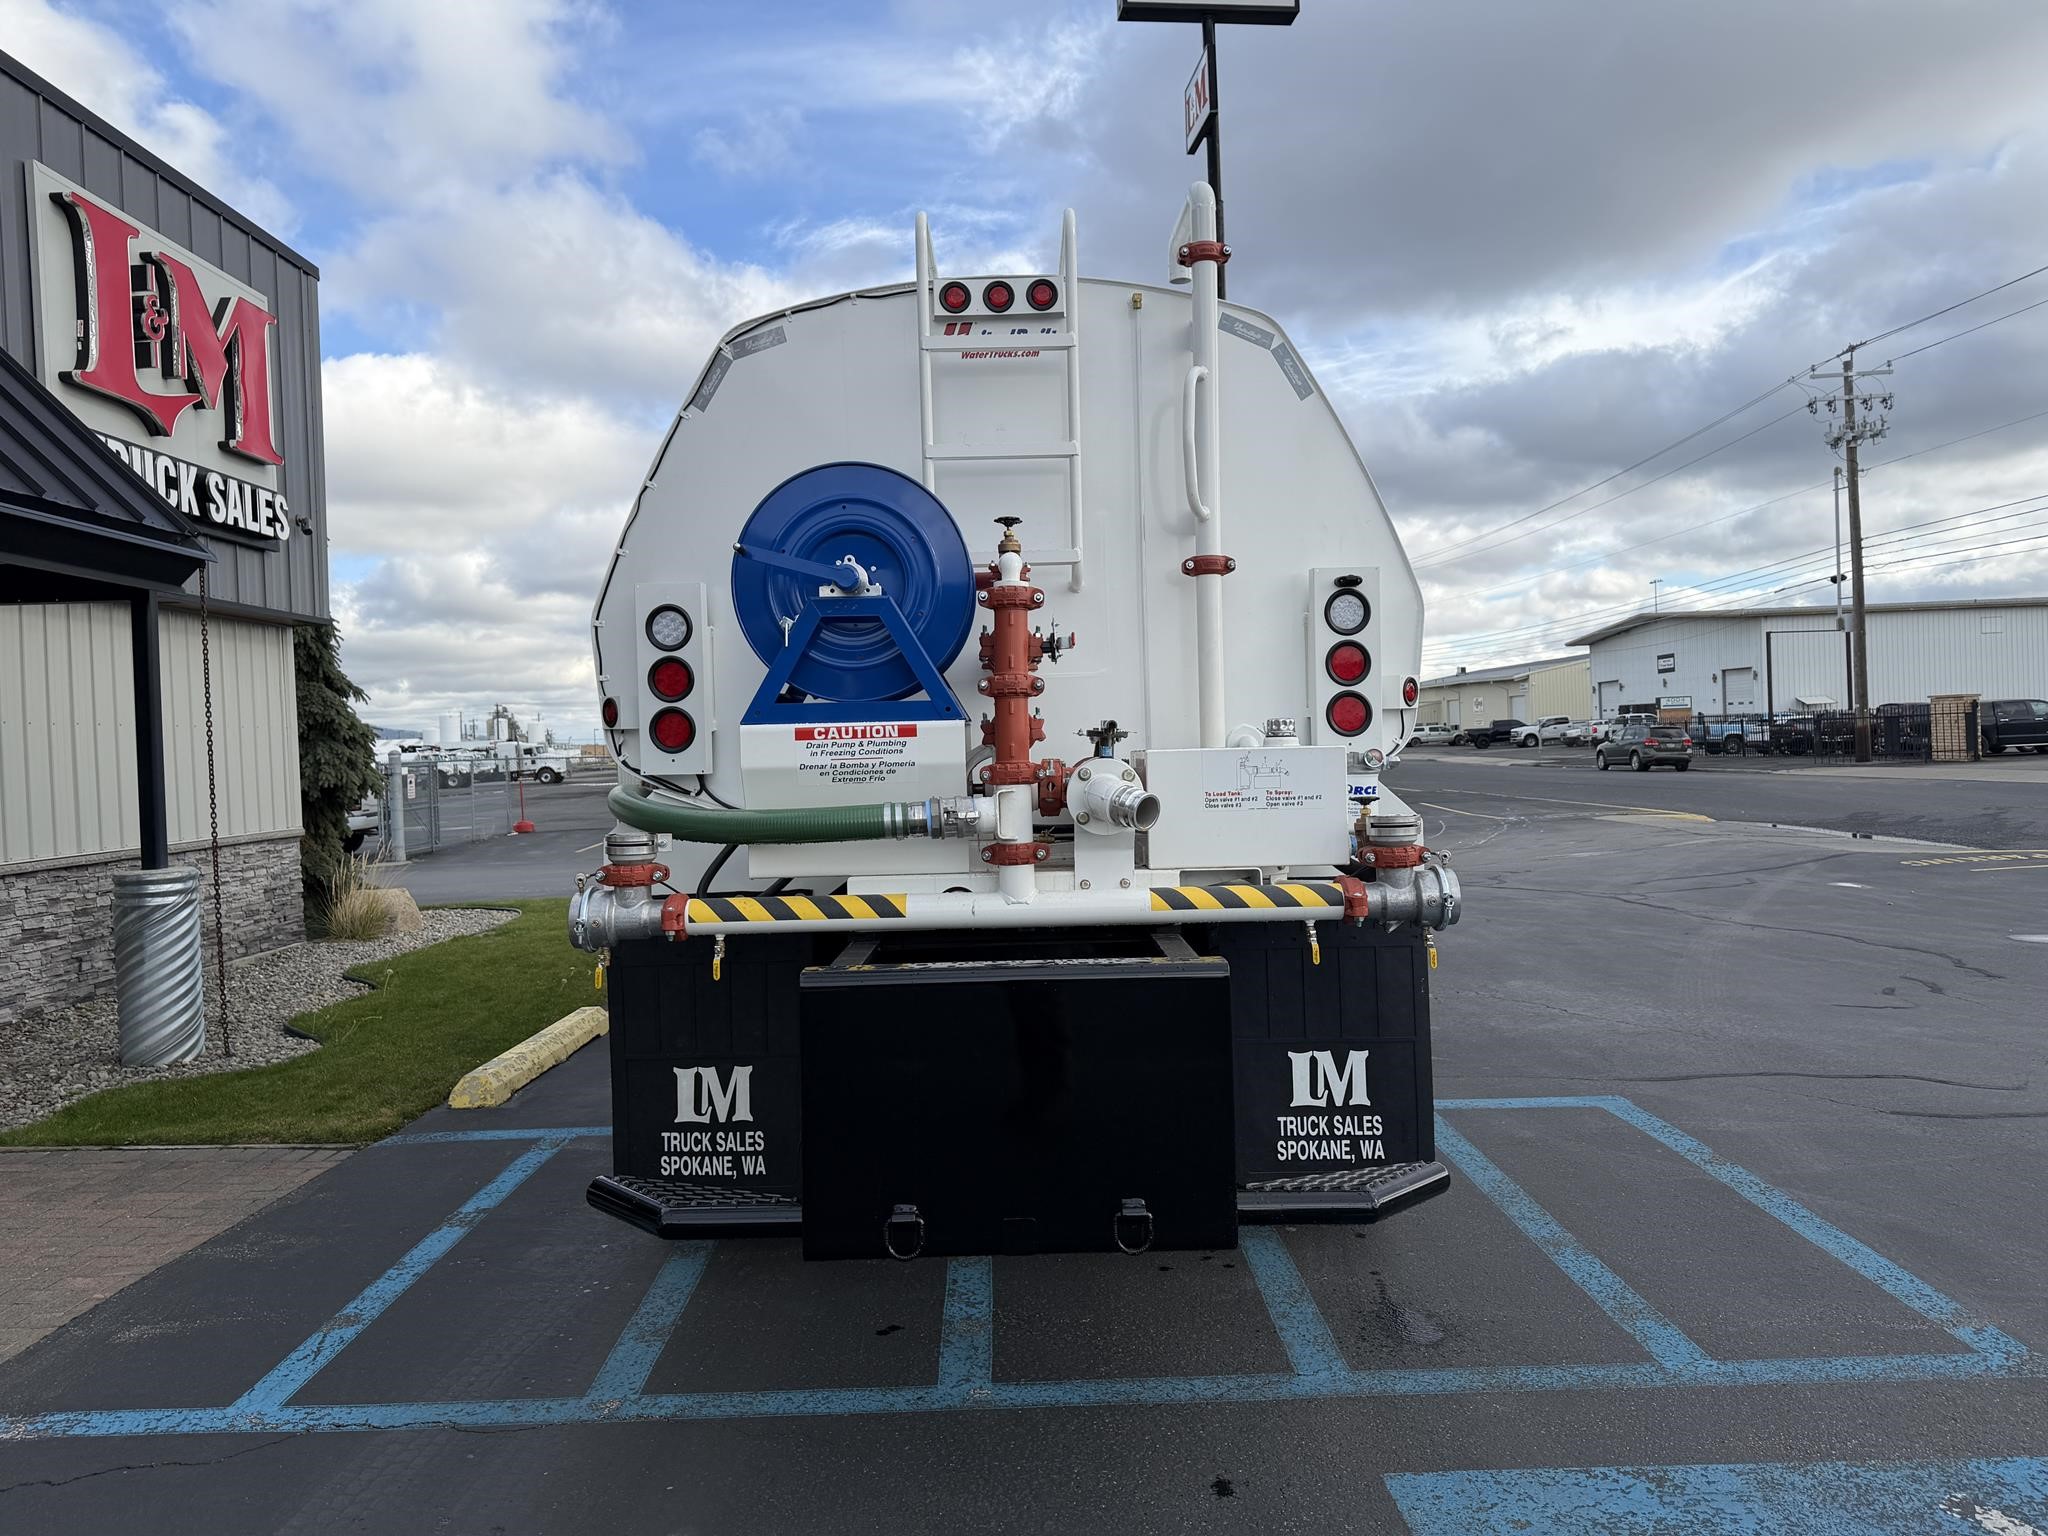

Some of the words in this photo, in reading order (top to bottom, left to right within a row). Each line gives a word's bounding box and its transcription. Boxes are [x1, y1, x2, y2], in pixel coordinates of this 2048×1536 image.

[961, 350, 1040, 359] WaterTrucks.com
[98, 434, 200, 516] UCK
[206, 472, 290, 541] SALES
[813, 725, 899, 740] CAUTION
[806, 741, 829, 749] Drain
[831, 741, 856, 749] Pump
[858, 740, 864, 748] &
[867, 740, 907, 748] Plumbing
[820, 749, 856, 757] Freezing
[858, 748, 904, 756] Conditions
[840, 761, 869, 769] Bomba
[1277, 1116, 1330, 1136] TRUCK
[1333, 1115, 1383, 1136] SALES
[661, 1132, 713, 1152] TRUCK
[716, 1131, 765, 1152] SALES
[1277, 1140, 1355, 1164] SPOKANE,
[1359, 1140, 1385, 1160] WA
[660, 1155, 737, 1180] SPOKANE,
[741, 1155, 766, 1176] WA
